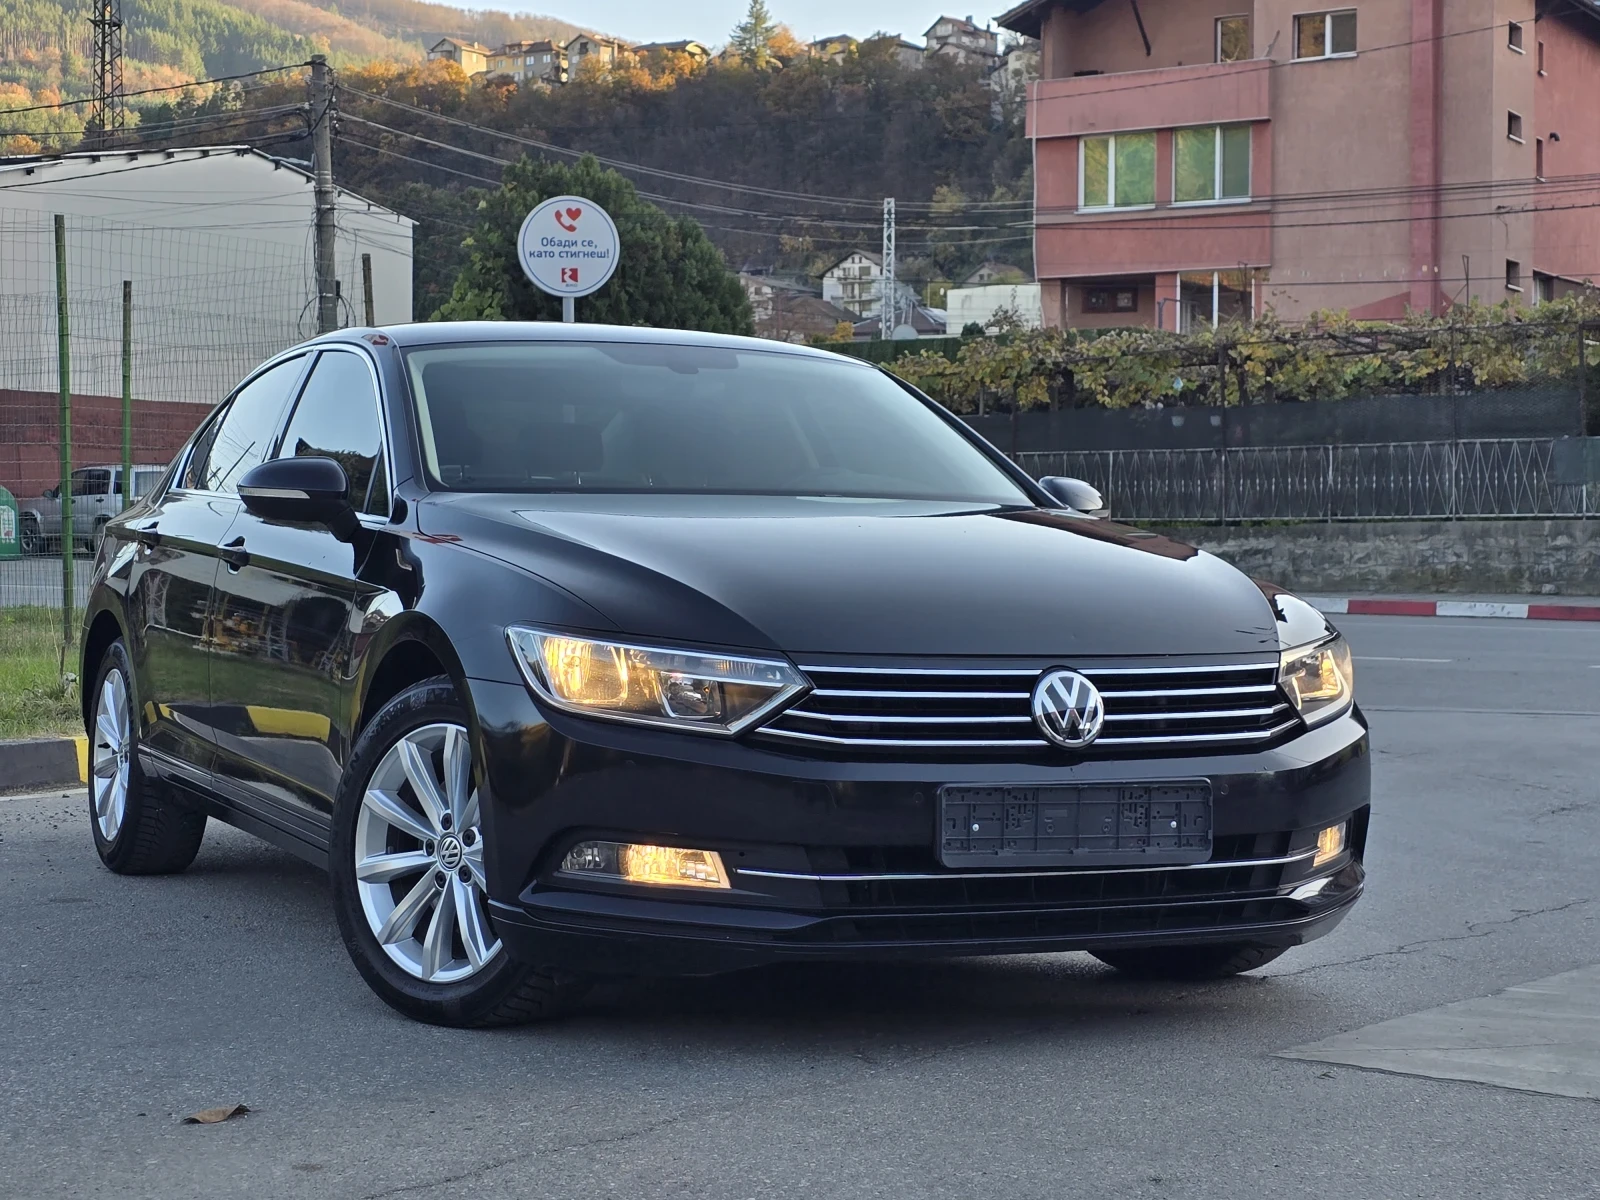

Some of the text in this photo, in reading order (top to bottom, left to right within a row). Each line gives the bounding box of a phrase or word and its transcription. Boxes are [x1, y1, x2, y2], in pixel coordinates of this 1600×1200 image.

[541, 237, 598, 249] Обади се,
[529, 249, 609, 259] като стигнеш!
[1034, 671, 1103, 746] VW
